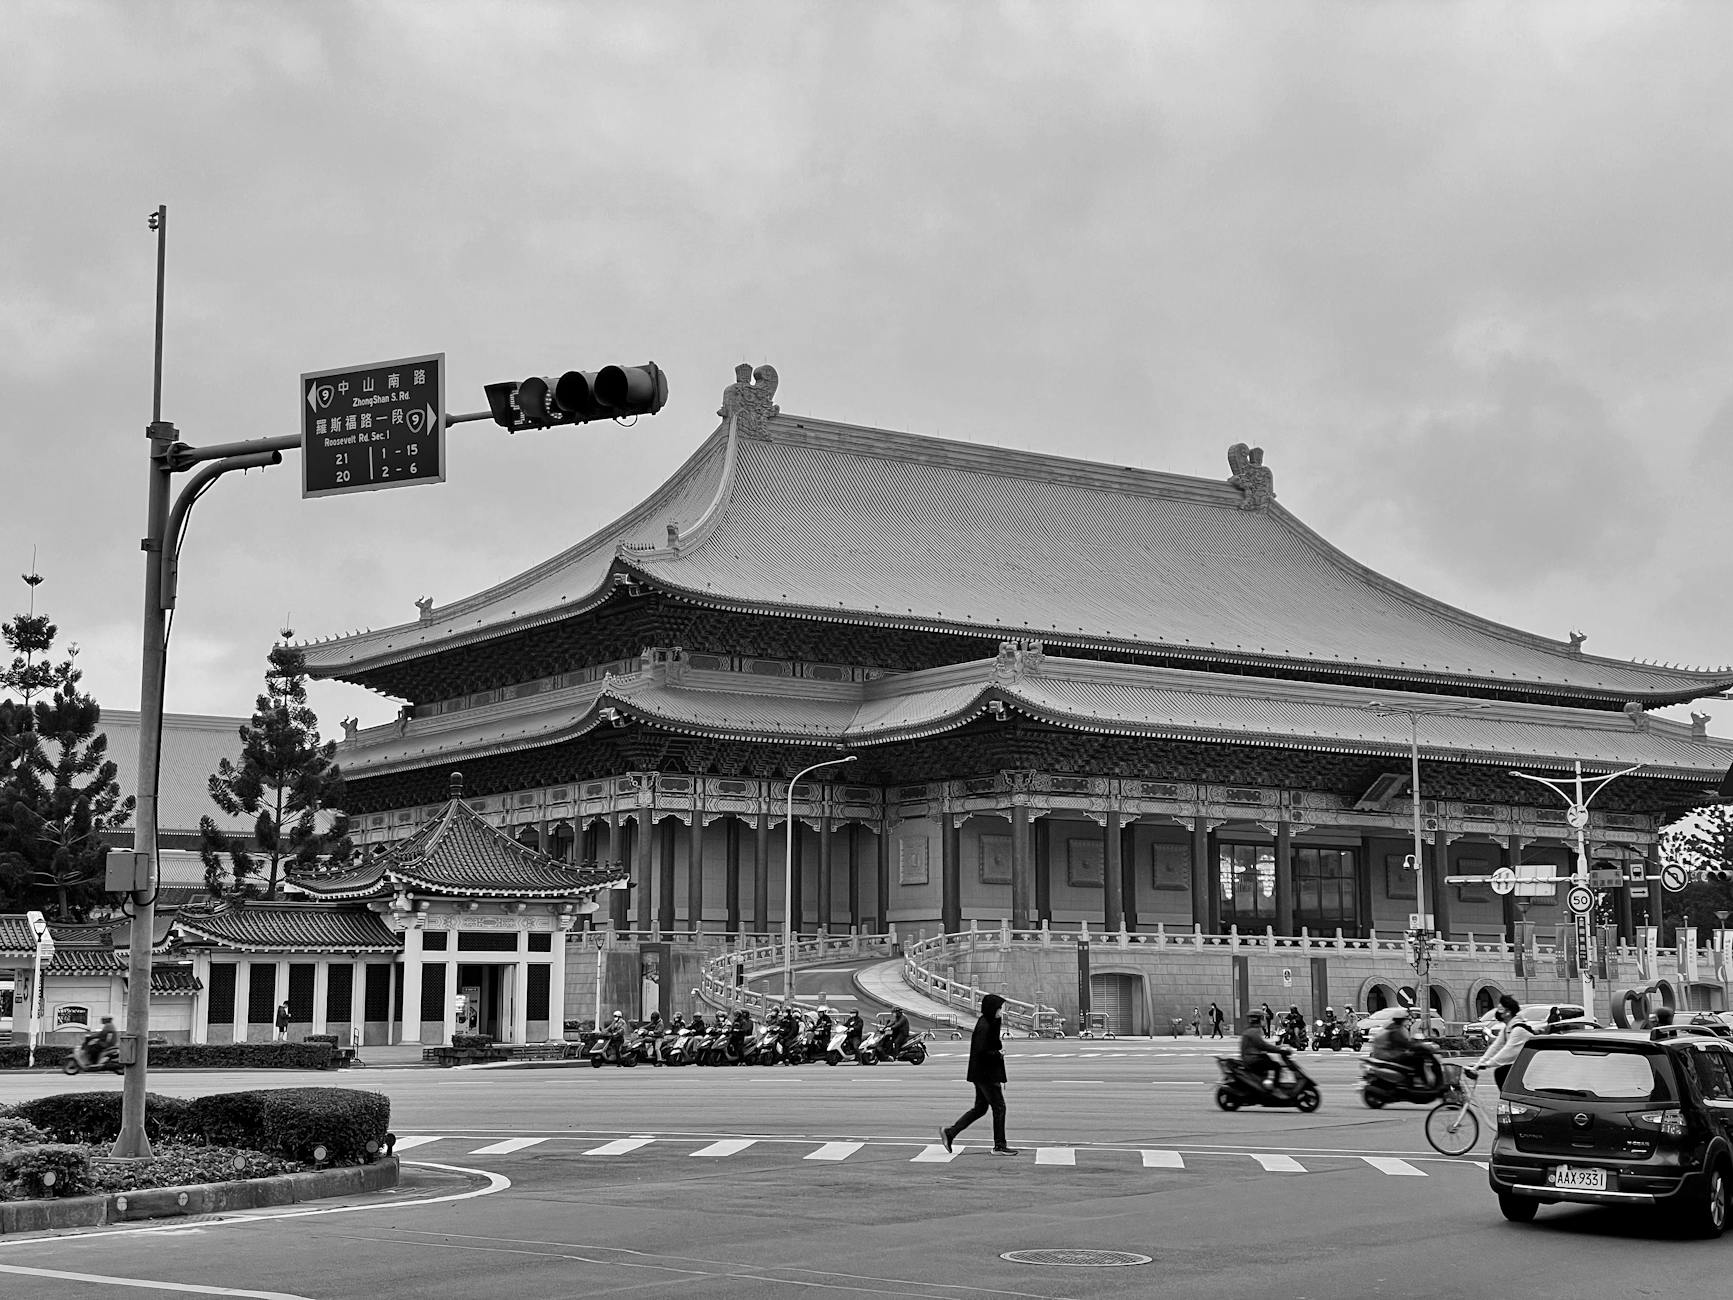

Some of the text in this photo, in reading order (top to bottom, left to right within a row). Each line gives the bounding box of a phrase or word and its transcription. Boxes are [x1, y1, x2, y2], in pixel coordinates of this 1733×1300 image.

[338, 369, 426, 395] 中山南路
[322, 390, 329, 400] 9
[352, 391, 410, 407] ZhongShan S. Rd.
[316, 408, 404, 435] 羅斯福路一段
[411, 414, 419, 425] 9
[324, 434, 356, 447] Roosevelt
[335, 453, 348, 465] 21
[336, 471, 350, 482] 20
[1573, 896, 1588, 905] 50
